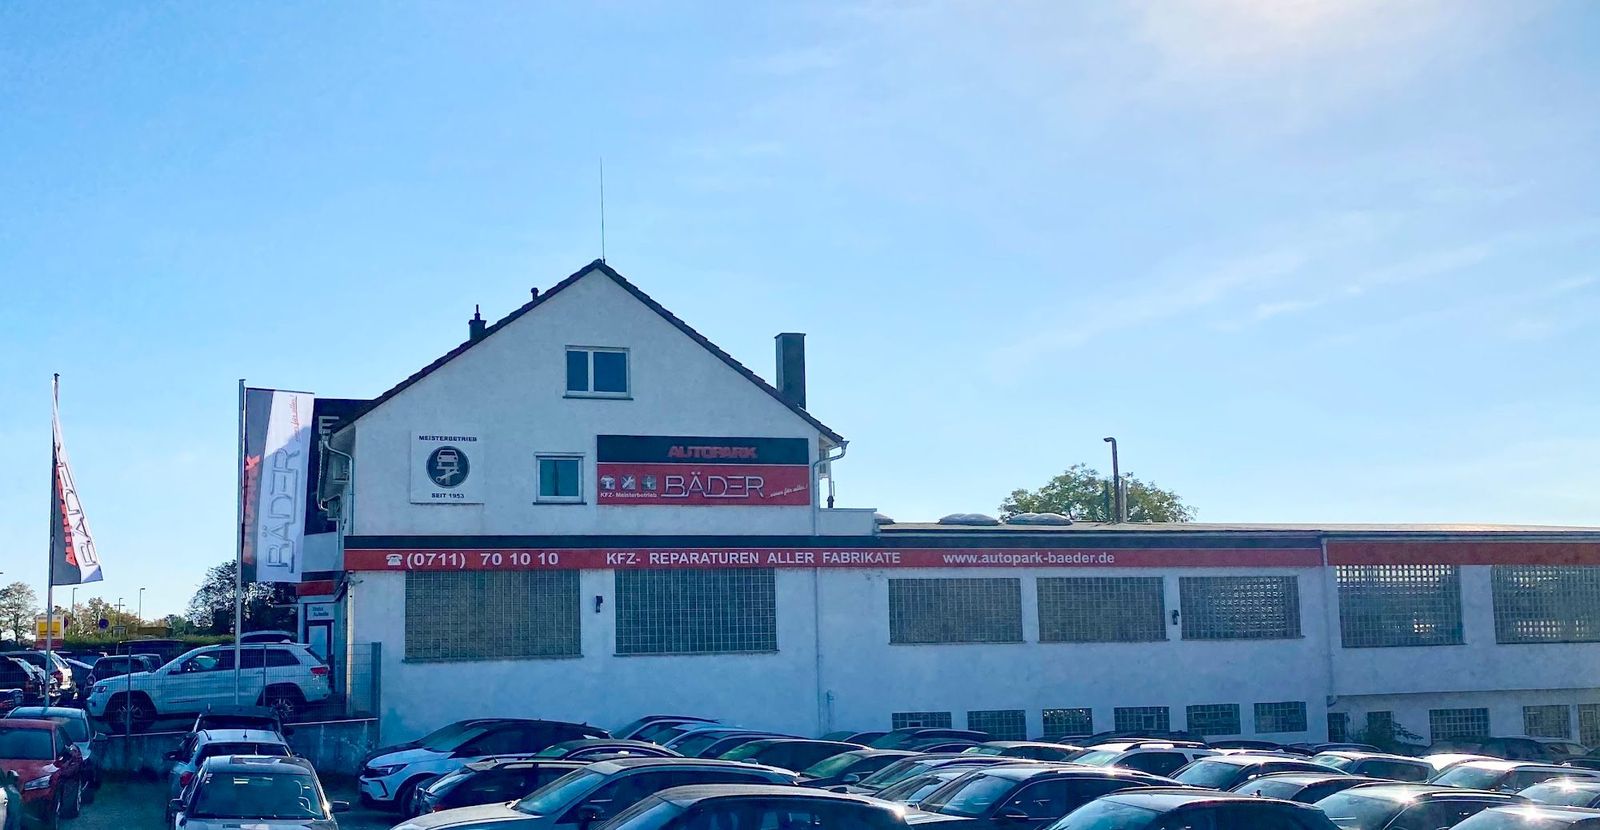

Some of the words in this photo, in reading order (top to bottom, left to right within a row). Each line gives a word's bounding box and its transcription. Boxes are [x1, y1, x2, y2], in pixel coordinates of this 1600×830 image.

[667, 445, 758, 458] AUTOPARK
[661, 471, 764, 498] BÄDER
[260, 447, 300, 574] BÄDER
[406, 552, 466, 569] (0711)
[480, 552, 503, 566] 70
[509, 552, 531, 565] 10
[537, 552, 559, 565] 10
[606, 552, 641, 565] KFZ-
[649, 552, 760, 564] REPARATUREN
[767, 552, 814, 564] ALLER
[822, 551, 901, 564] FABRIKATE
[942, 551, 1115, 566] www.autopark-baeder.de
